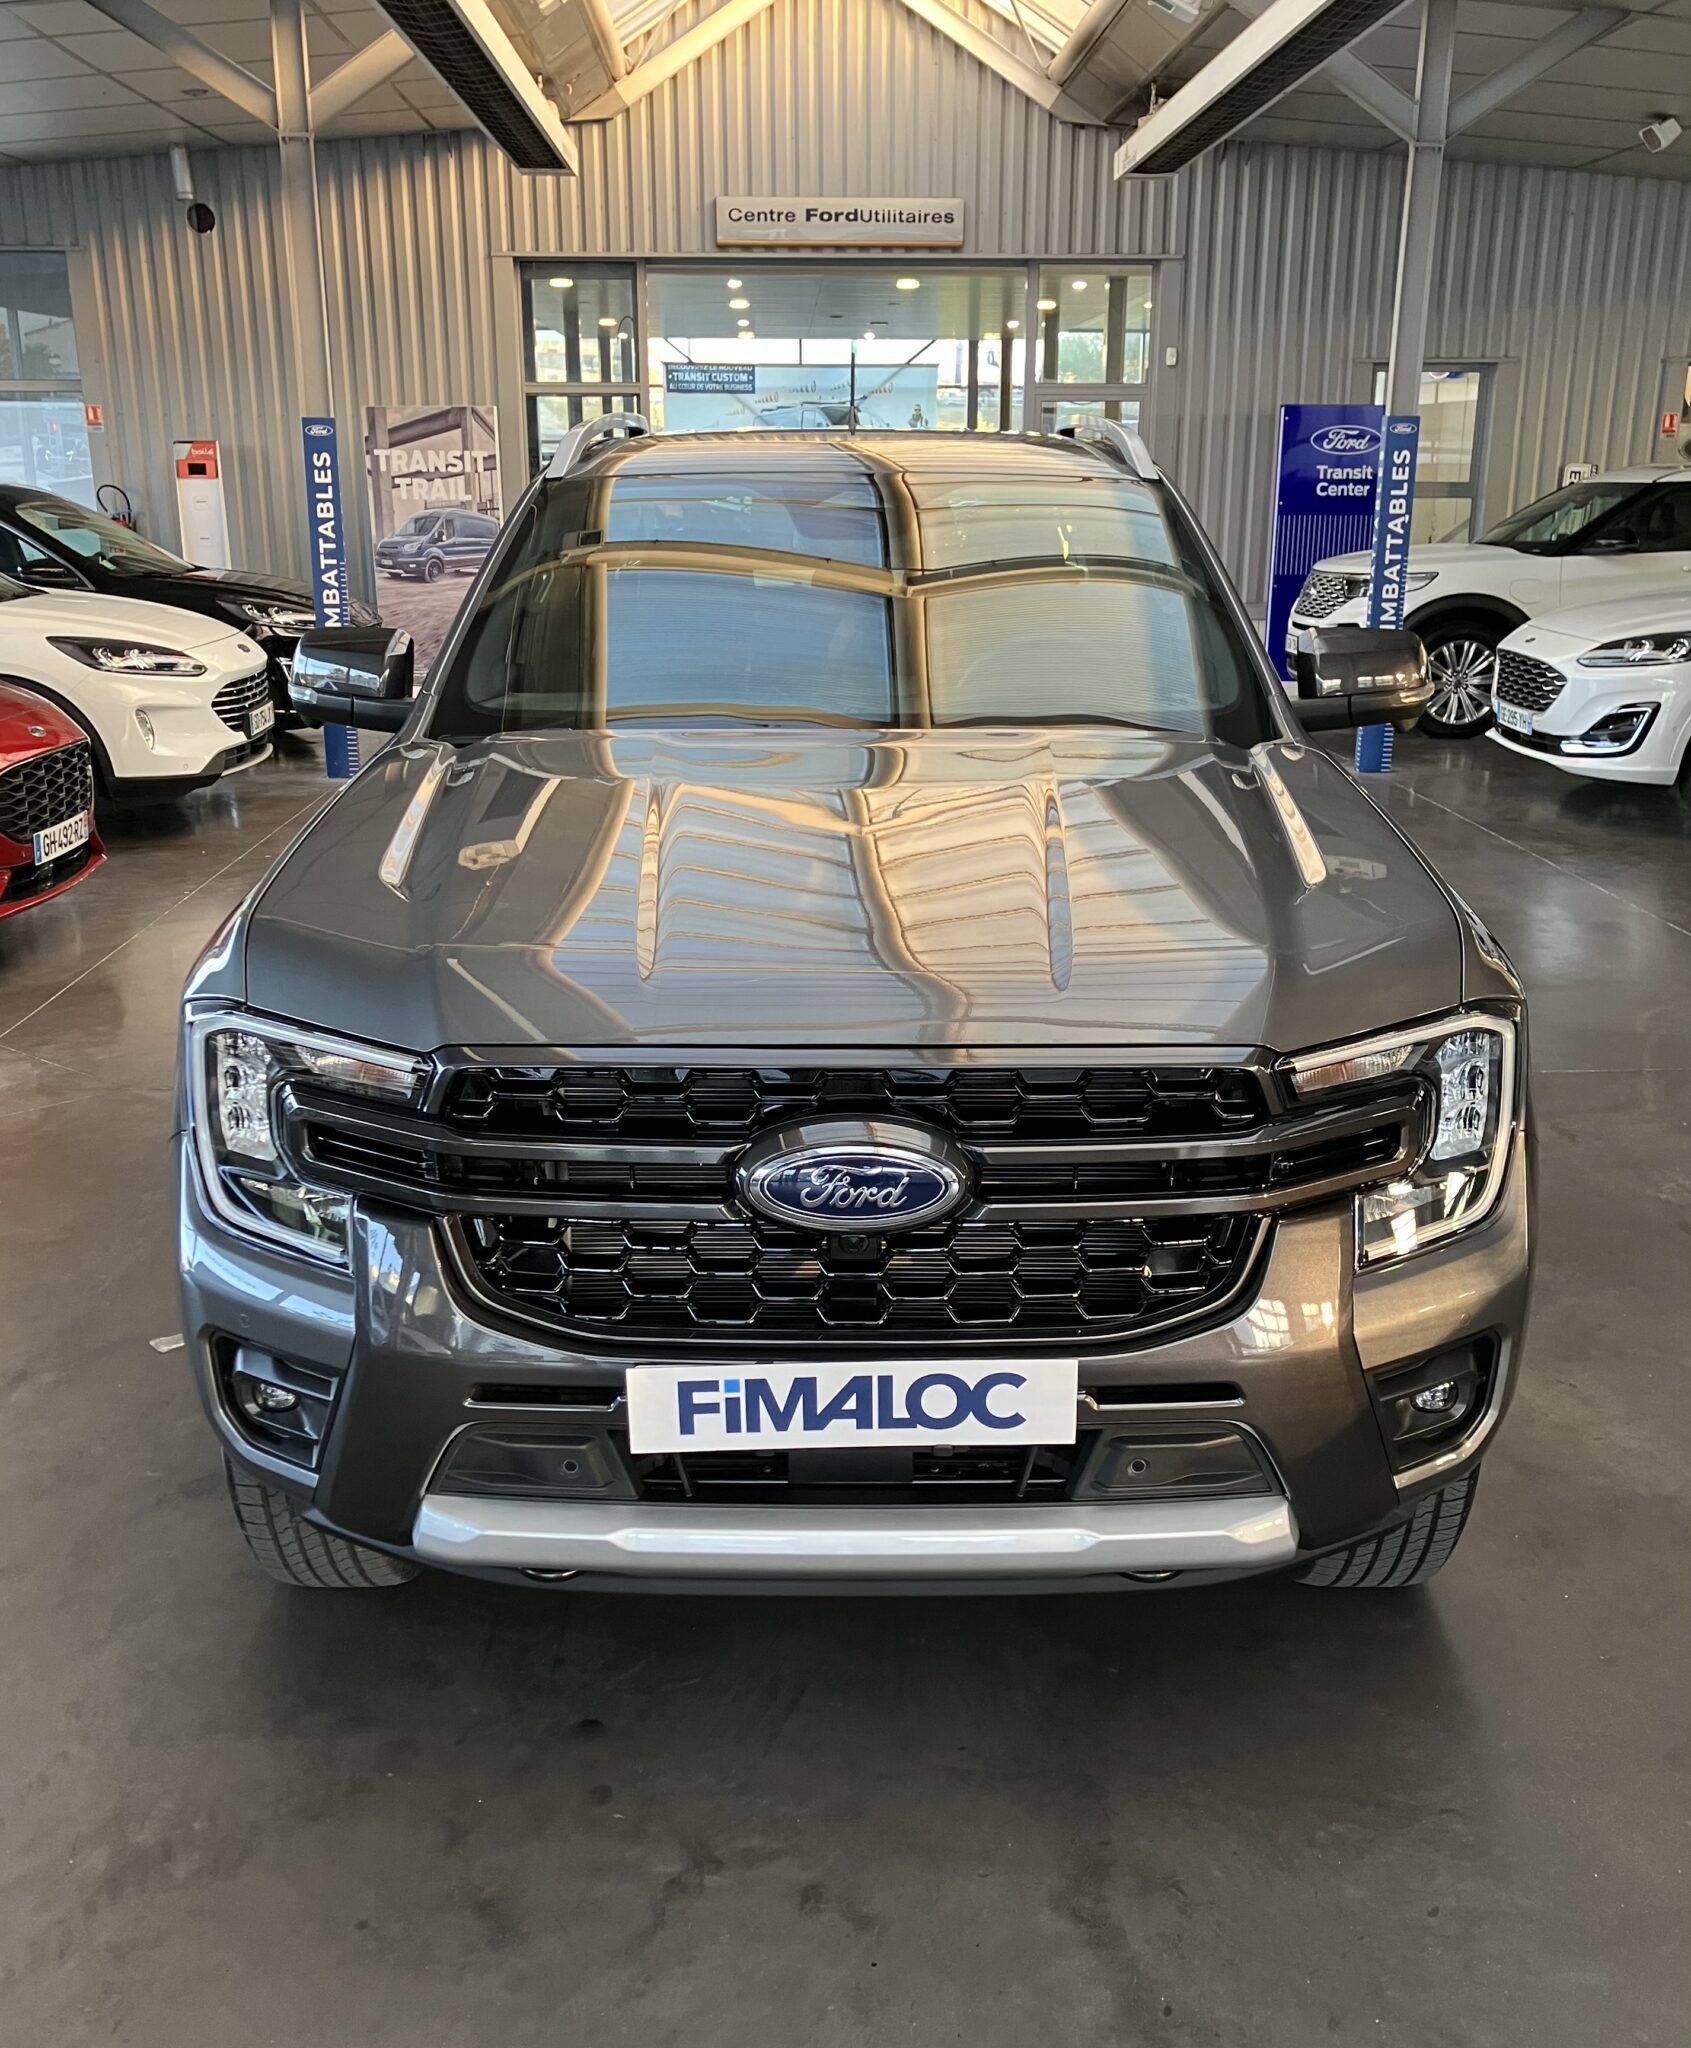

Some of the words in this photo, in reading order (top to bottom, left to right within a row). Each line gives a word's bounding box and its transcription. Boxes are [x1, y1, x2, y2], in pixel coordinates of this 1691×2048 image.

[728, 207, 796, 222] Centre
[672, 372, 710, 382] TRANSIT
[711, 372, 748, 382] CUSTOM
[1322, 428, 1371, 450] Ford
[373, 448, 489, 473] TRANSIT
[1316, 465, 1374, 480] Transit
[394, 477, 473, 501] TRAIL
[1316, 482, 1370, 496] Center
[313, 452, 342, 628] MBATTABLES
[1379, 449, 1411, 630] IMBATTABLES
[799, 1164, 911, 1209] Ford
